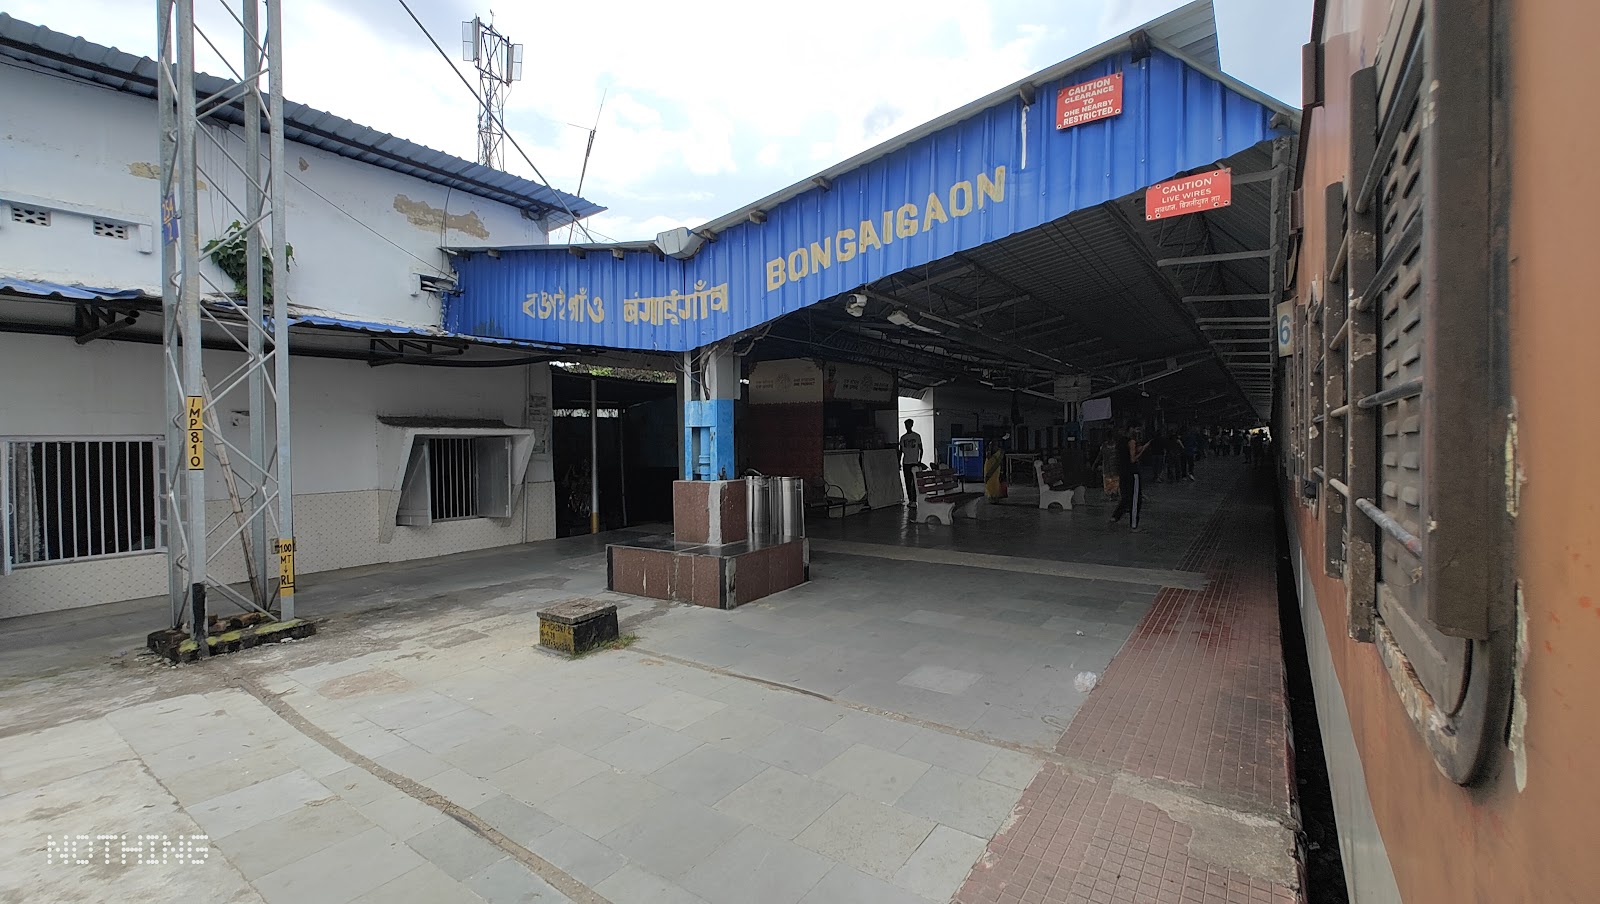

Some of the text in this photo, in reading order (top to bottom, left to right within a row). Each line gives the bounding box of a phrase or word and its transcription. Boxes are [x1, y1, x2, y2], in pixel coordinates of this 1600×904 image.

[1064, 85, 1114, 104] CLEARANCE
[1068, 78, 1110, 96] CAUTION
[1063, 107, 1113, 125] RESTRICTED
[1064, 99, 1114, 117] OHE NEARBY
[1162, 177, 1212, 194] CAUTION
[1162, 188, 1211, 204] LIVE WIRES
[766, 165, 1006, 292] BONGAIGAON
[1280, 314, 1291, 345] 6
[189, 398, 201, 428] IMP
[280, 554, 292, 564] MT
[281, 575, 294, 586] RL
